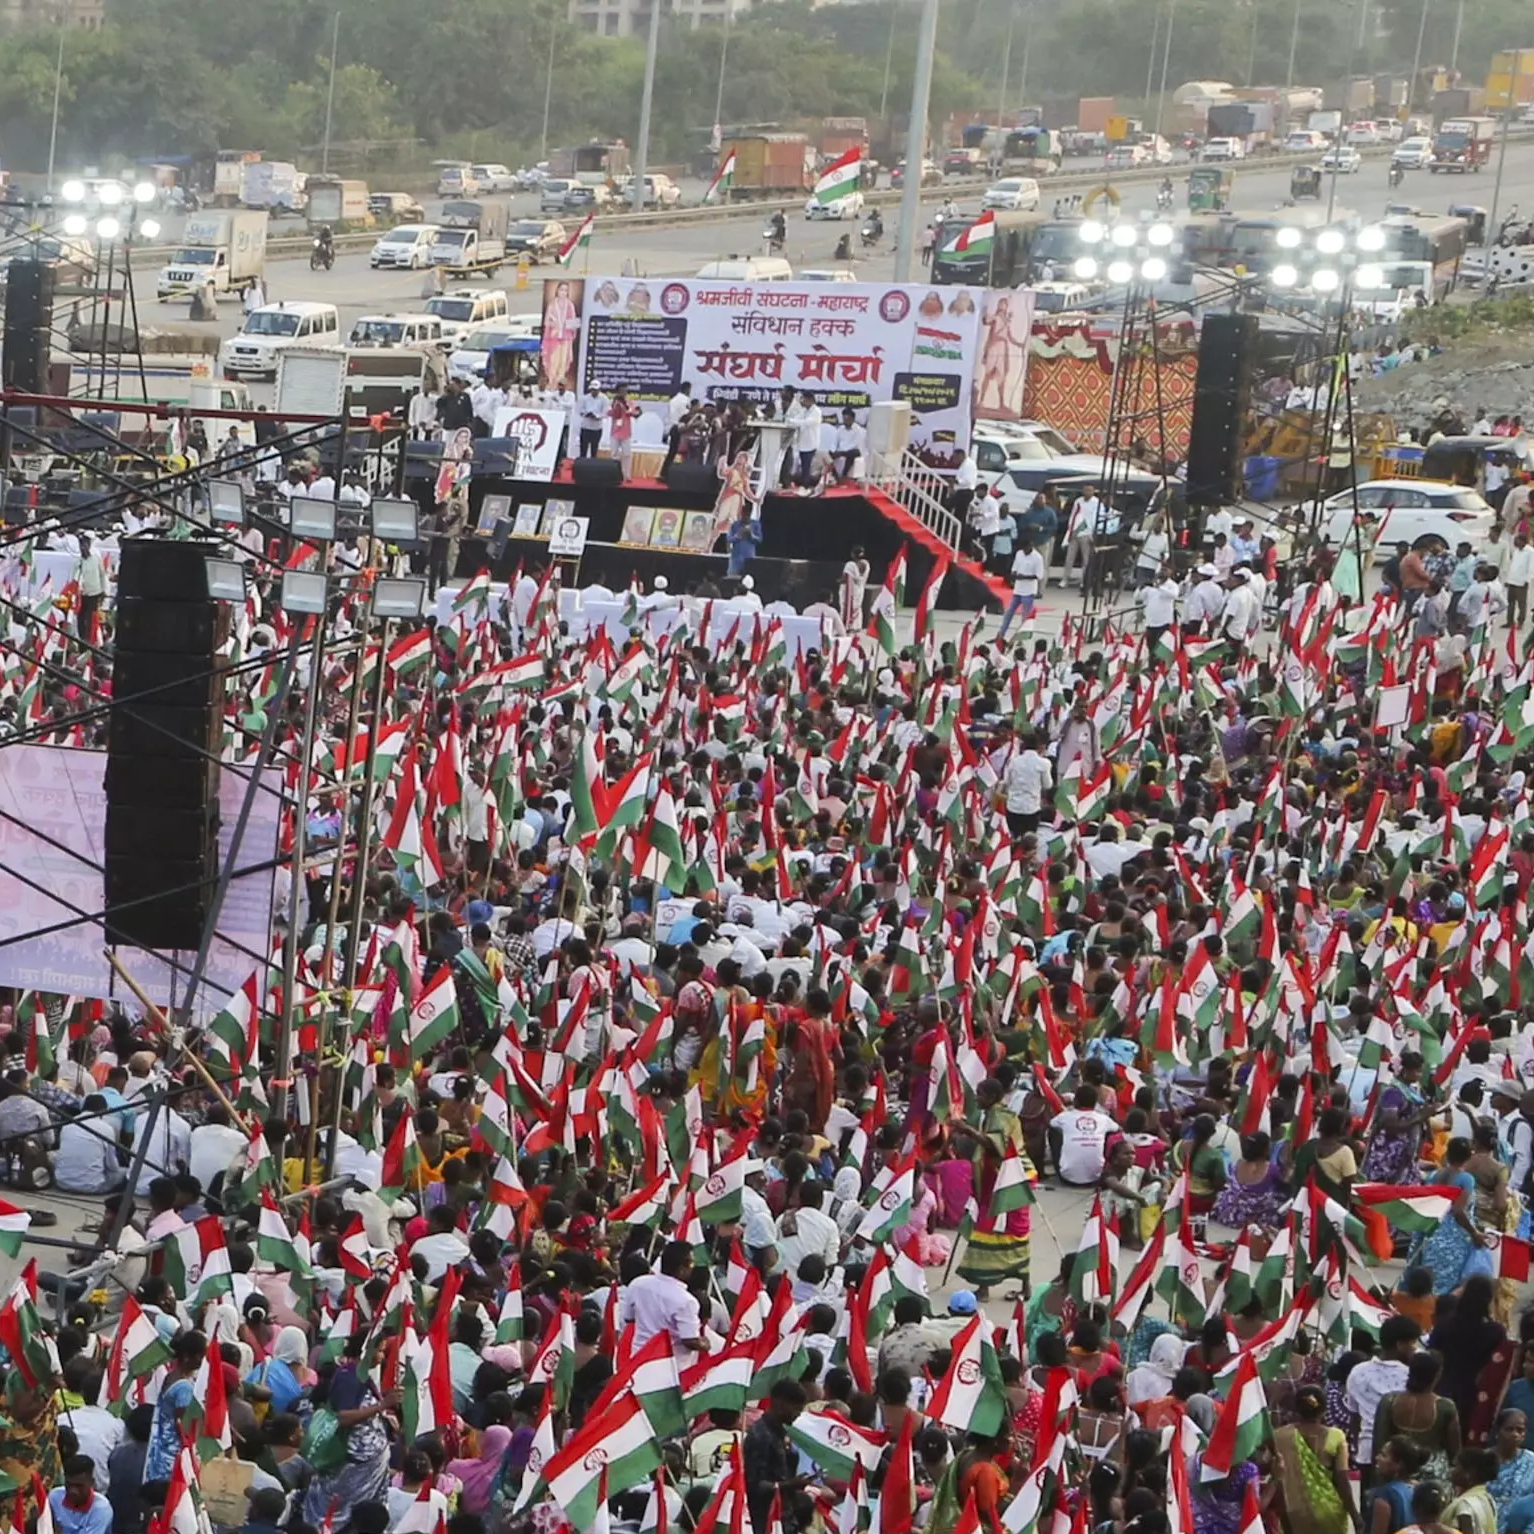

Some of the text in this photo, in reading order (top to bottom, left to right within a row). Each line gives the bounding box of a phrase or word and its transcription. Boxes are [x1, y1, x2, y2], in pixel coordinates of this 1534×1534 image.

[697, 287, 753, 306] श्रमजीवी
[757, 289, 809, 309] संघटना
[818, 295, 870, 313] महाराष्ट्र
[731, 310, 857, 338] संविधान हक्क
[694, 341, 786, 381] संघर्ष
[795, 344, 885, 385] मोर्चा
